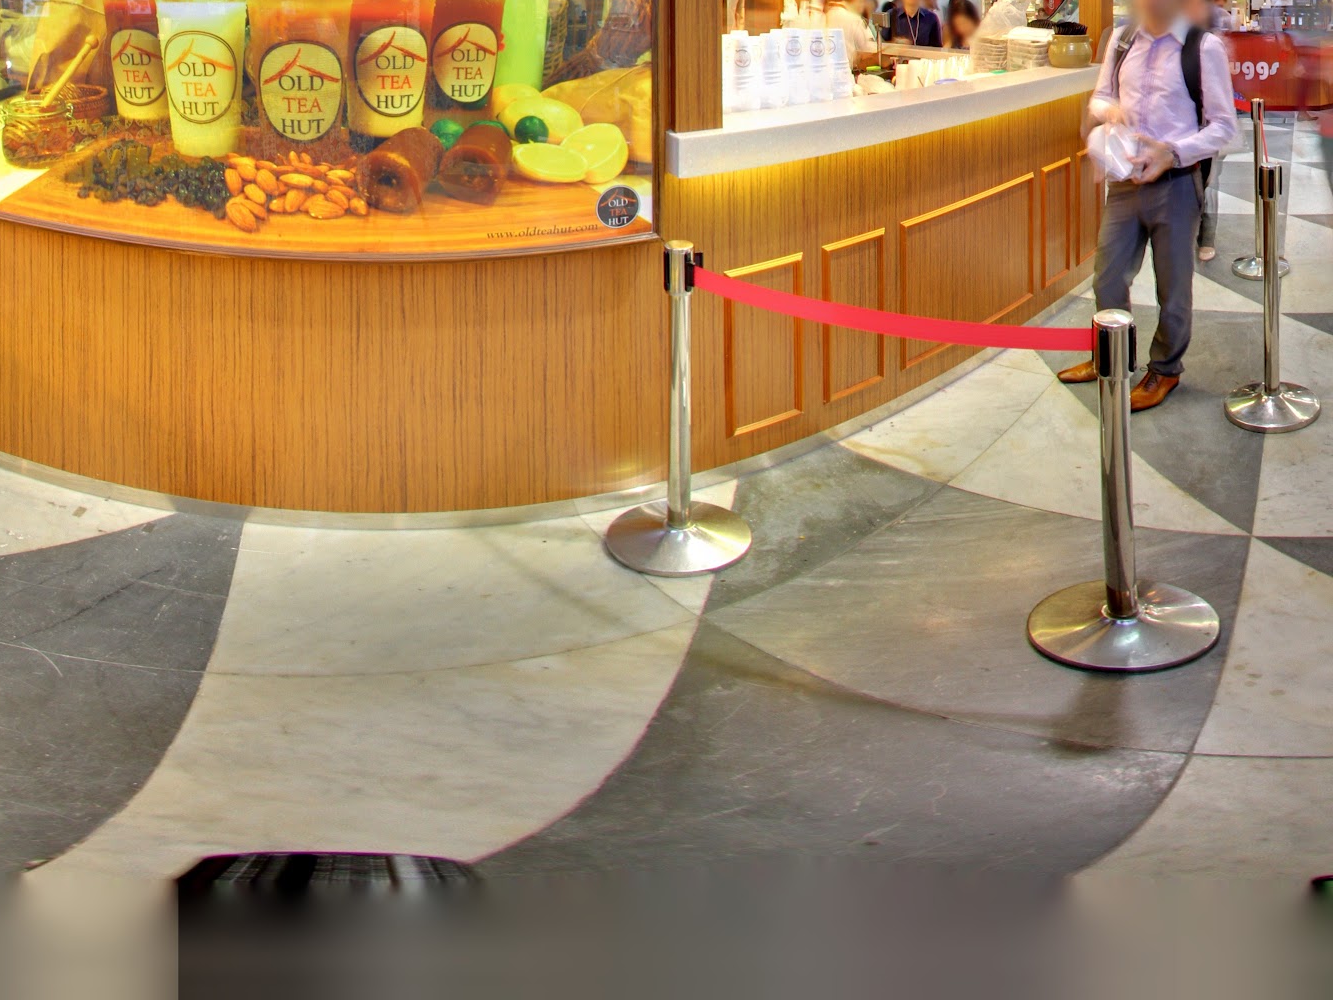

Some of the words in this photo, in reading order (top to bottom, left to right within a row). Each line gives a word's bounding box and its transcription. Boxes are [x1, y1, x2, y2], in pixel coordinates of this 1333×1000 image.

[119, 52, 152, 67] OLD
[375, 55, 415, 70] OLD
[451, 49, 487, 63] OLD
[123, 69, 152, 83] TEA
[177, 61, 217, 77] OLD
[452, 66, 483, 80] TEA
[1229, 61, 1280, 81] uggs
[181, 81, 218, 97] TEA
[278, 74, 325, 92] OLD
[376, 74, 412, 90] TEA
[123, 86, 154, 100] HUT
[451, 84, 485, 97] HUT
[181, 100, 219, 117] HUT
[282, 97, 323, 114] TEA
[376, 93, 414, 109] HUT
[280, 118, 325, 135] HUT
[608, 197, 629, 208] OLD
[609, 207, 628, 217] TEA
[608, 216, 629, 226] HUT
[486, 223, 599, 240] www.oldteahut.com
